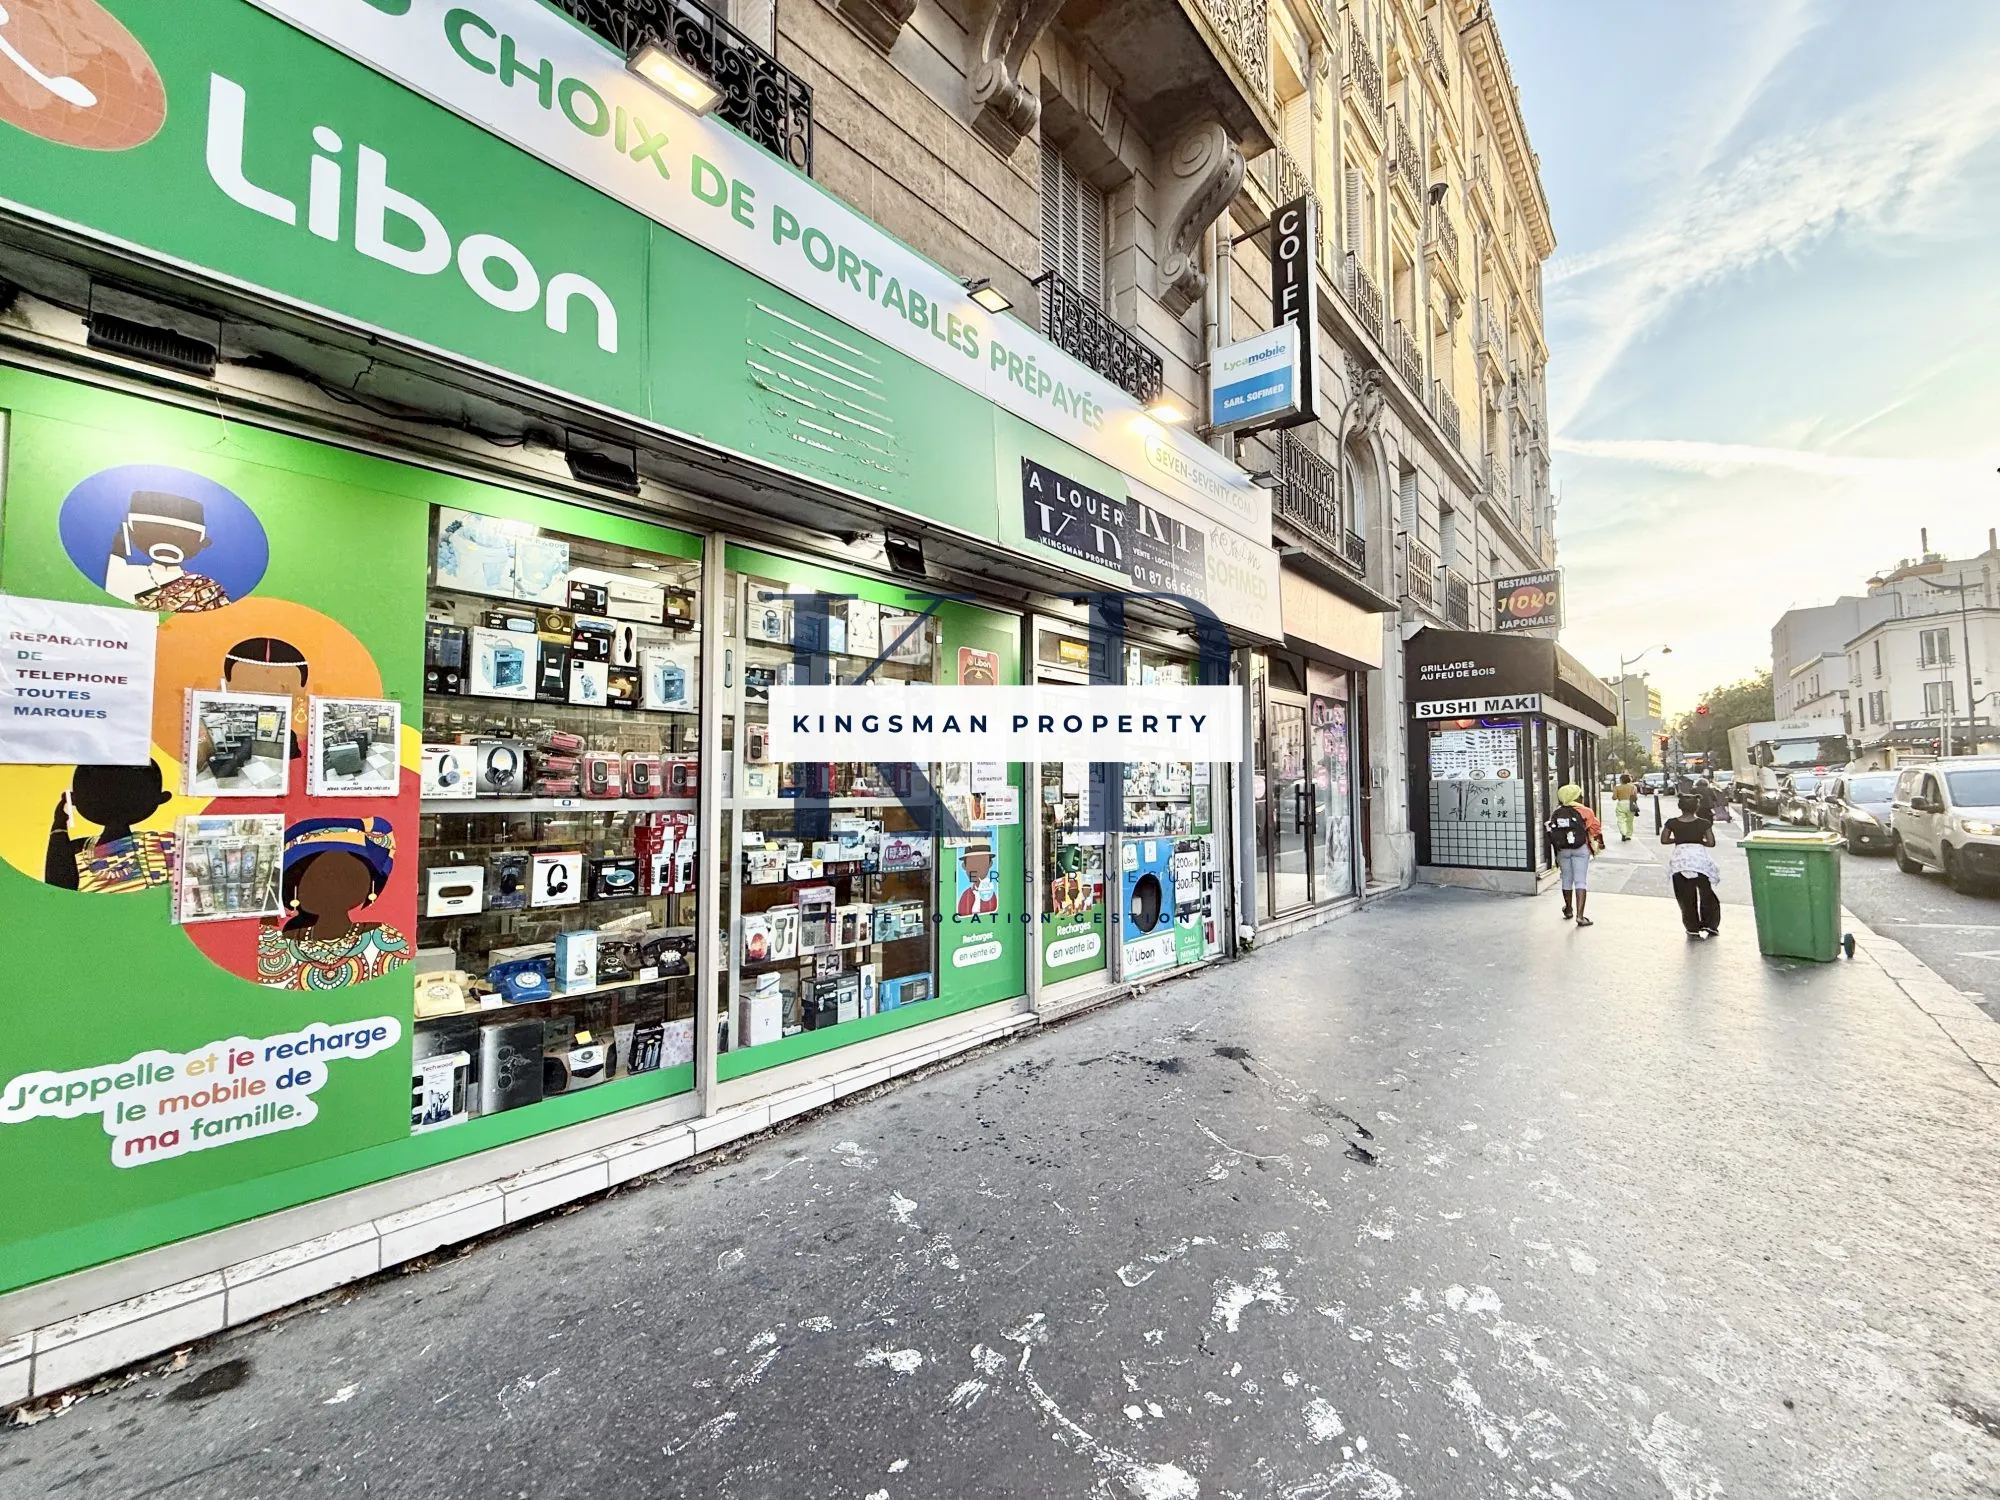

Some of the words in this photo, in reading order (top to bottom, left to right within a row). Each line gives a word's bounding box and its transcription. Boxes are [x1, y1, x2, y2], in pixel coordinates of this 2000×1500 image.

[206, 71, 618, 354] Libon
[444, 8, 670, 180] CHOIX
[691, 153, 756, 230] DE
[773, 205, 979, 360] PORTABLES
[991, 344, 1104, 432] PRÉPAYÉS
[1223, 341, 1286, 373] Lycamobile
[1223, 395, 1245, 409] SARL
[1246, 383, 1284, 402] SOFIMED
[1155, 447, 1251, 513] SEVEN-SEVENTY.COM
[1029, 471, 1043, 492] A
[1056, 481, 1124, 528] LOUER
[1042, 536, 1084, 558] KINGSMAN
[1085, 551, 1122, 571] PROPERTY
[1132, 547, 1151, 560] VENTE
[1134, 564, 1146, 581] 01
[1149, 570, 1162, 586] 87
[1165, 576, 1178, 594] 66
[1180, 582, 1192, 597] 66
[1194, 587, 1206, 601] 92
[1497, 572, 1556, 590] RESTAURANT
[1498, 614, 1557, 630] JAPONAIS
[9, 631, 129, 651] REPARATION
[17, 650, 43, 661] DE
[1420, 660, 1475, 673] GRILLADES
[1420, 672, 1434, 681] AU
[1435, 670, 1454, 680] FEU
[1455, 669, 1470, 678] DE
[1472, 667, 1496, 677] BOIS
[16, 669, 128, 685] TELEPHONE
[15, 687, 91, 700] TOUTES
[13, 706, 107, 720] MARQUES
[1420, 700, 1478, 716] SUSHI
[1484, 696, 1537, 713] MAKI
[962, 931, 994, 944] Recharges
[1056, 921, 1092, 936] Recharges
[959, 953, 968, 961] en
[969, 949, 988, 960] vente
[989, 946, 997, 955] ici
[1053, 948, 1063, 959] en
[1065, 943, 1085, 956] vente
[1086, 938, 1095, 950] ici
[1135, 948, 1155, 962] Libon
[7, 1063, 174, 1111] J'appelle
[185, 1053, 219, 1076] et
[227, 1047, 255, 1075] je
[264, 1024, 387, 1062] recharge
[116, 1101, 146, 1125] le
[157, 1075, 267, 1116] mobile
[275, 1068, 312, 1090] de
[124, 1127, 180, 1157] ma
[190, 1101, 302, 1141] famille.
